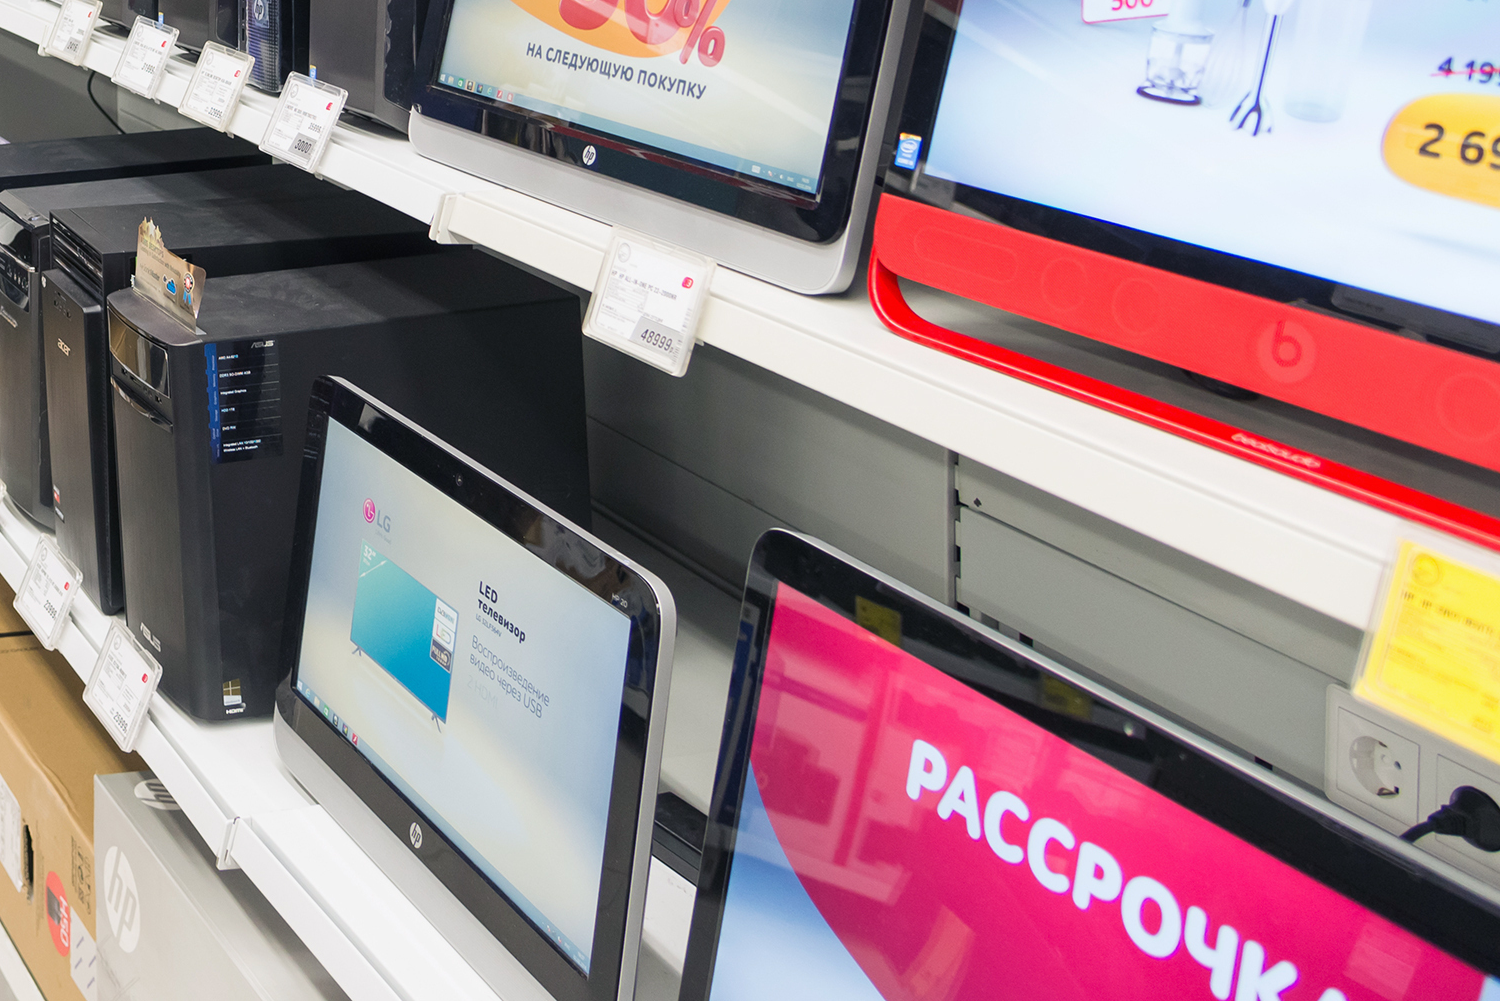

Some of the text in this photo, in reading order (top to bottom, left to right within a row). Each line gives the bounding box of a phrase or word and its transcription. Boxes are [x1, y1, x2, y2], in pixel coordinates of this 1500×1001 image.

[526, 40, 708, 101] НА СЛЕДУЮЩУЮ ПОКУПКУ
[1465, 60, 1500, 87] 19
[582, 144, 597, 166] hp
[1418, 122, 1446, 159] 2
[57, 337, 71, 357] acer
[250, 339, 276, 349] ASUS
[376, 509, 391, 533] LG
[479, 580, 498, 604] LED
[140, 621, 162, 653] ASUS
[477, 598, 526, 644] телевизор
[469, 653, 544, 719] видео через USB
[471, 634, 551, 708] Воспроизведение
[408, 820, 423, 849] hp
[904, 738, 1350, 1001] РАССРОЧК
[104, 846, 140, 953] hp
[58, 894, 70, 949] H50
